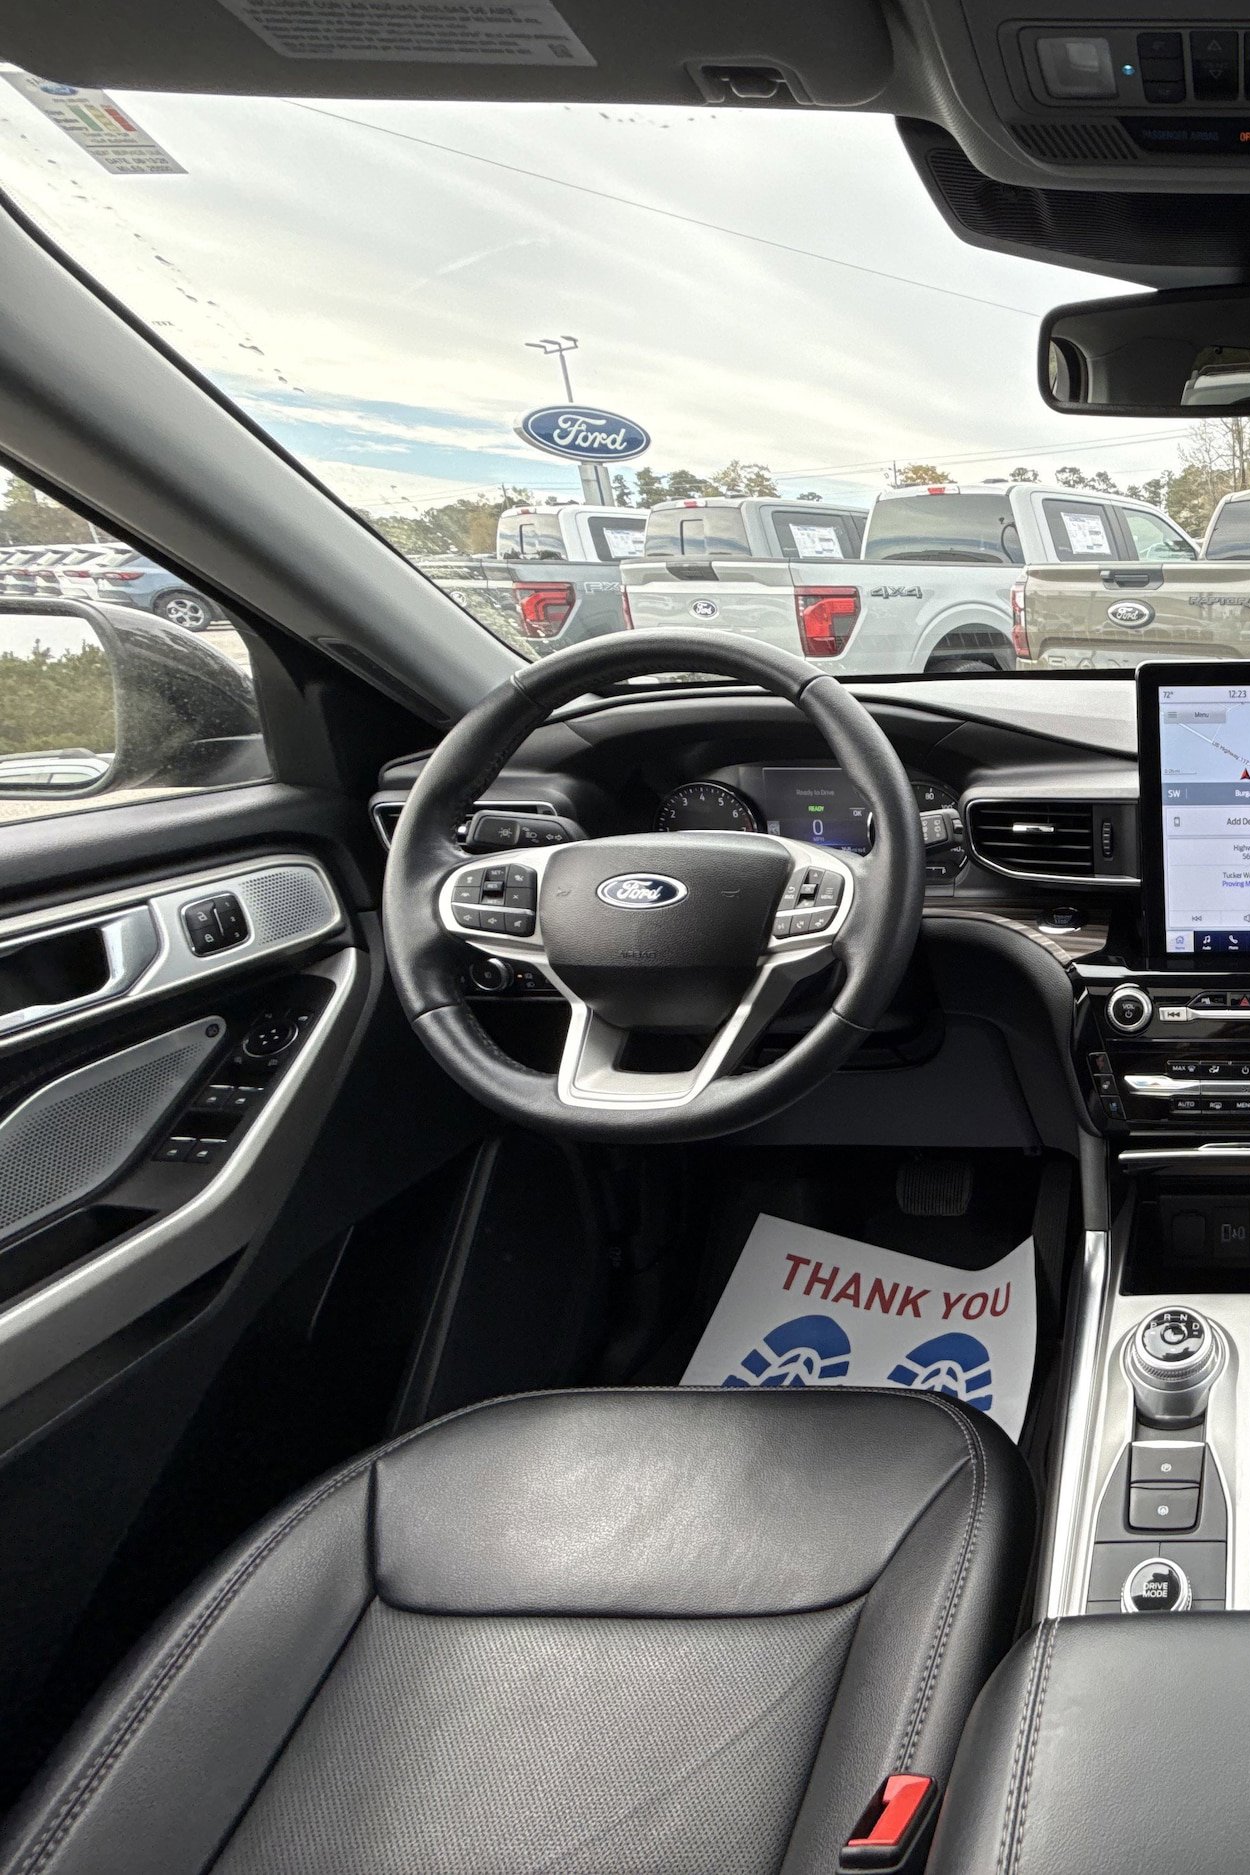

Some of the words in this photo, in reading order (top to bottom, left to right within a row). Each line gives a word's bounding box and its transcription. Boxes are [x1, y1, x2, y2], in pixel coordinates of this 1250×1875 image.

[553, 414, 627, 450] Ford
[583, 581, 620, 593] FX
[1116, 606, 1140, 620] Ford
[796, 789, 813, 797] Ready
[925, 792, 935, 800] 80
[1167, 789, 1181, 798] SW
[1226, 817, 1242, 826] Add
[812, 819, 824, 836] 0
[1222, 880, 1244, 888] Proving
[616, 880, 664, 900] Ford
[781, 1253, 930, 1318] THANK
[940, 1280, 1011, 1321] YOU
[1163, 1313, 1171, 1321] R
[1192, 1322, 1200, 1330] D
[1142, 1582, 1168, 1590] DRIVE
[1142, 1590, 1168, 1598] MODE
